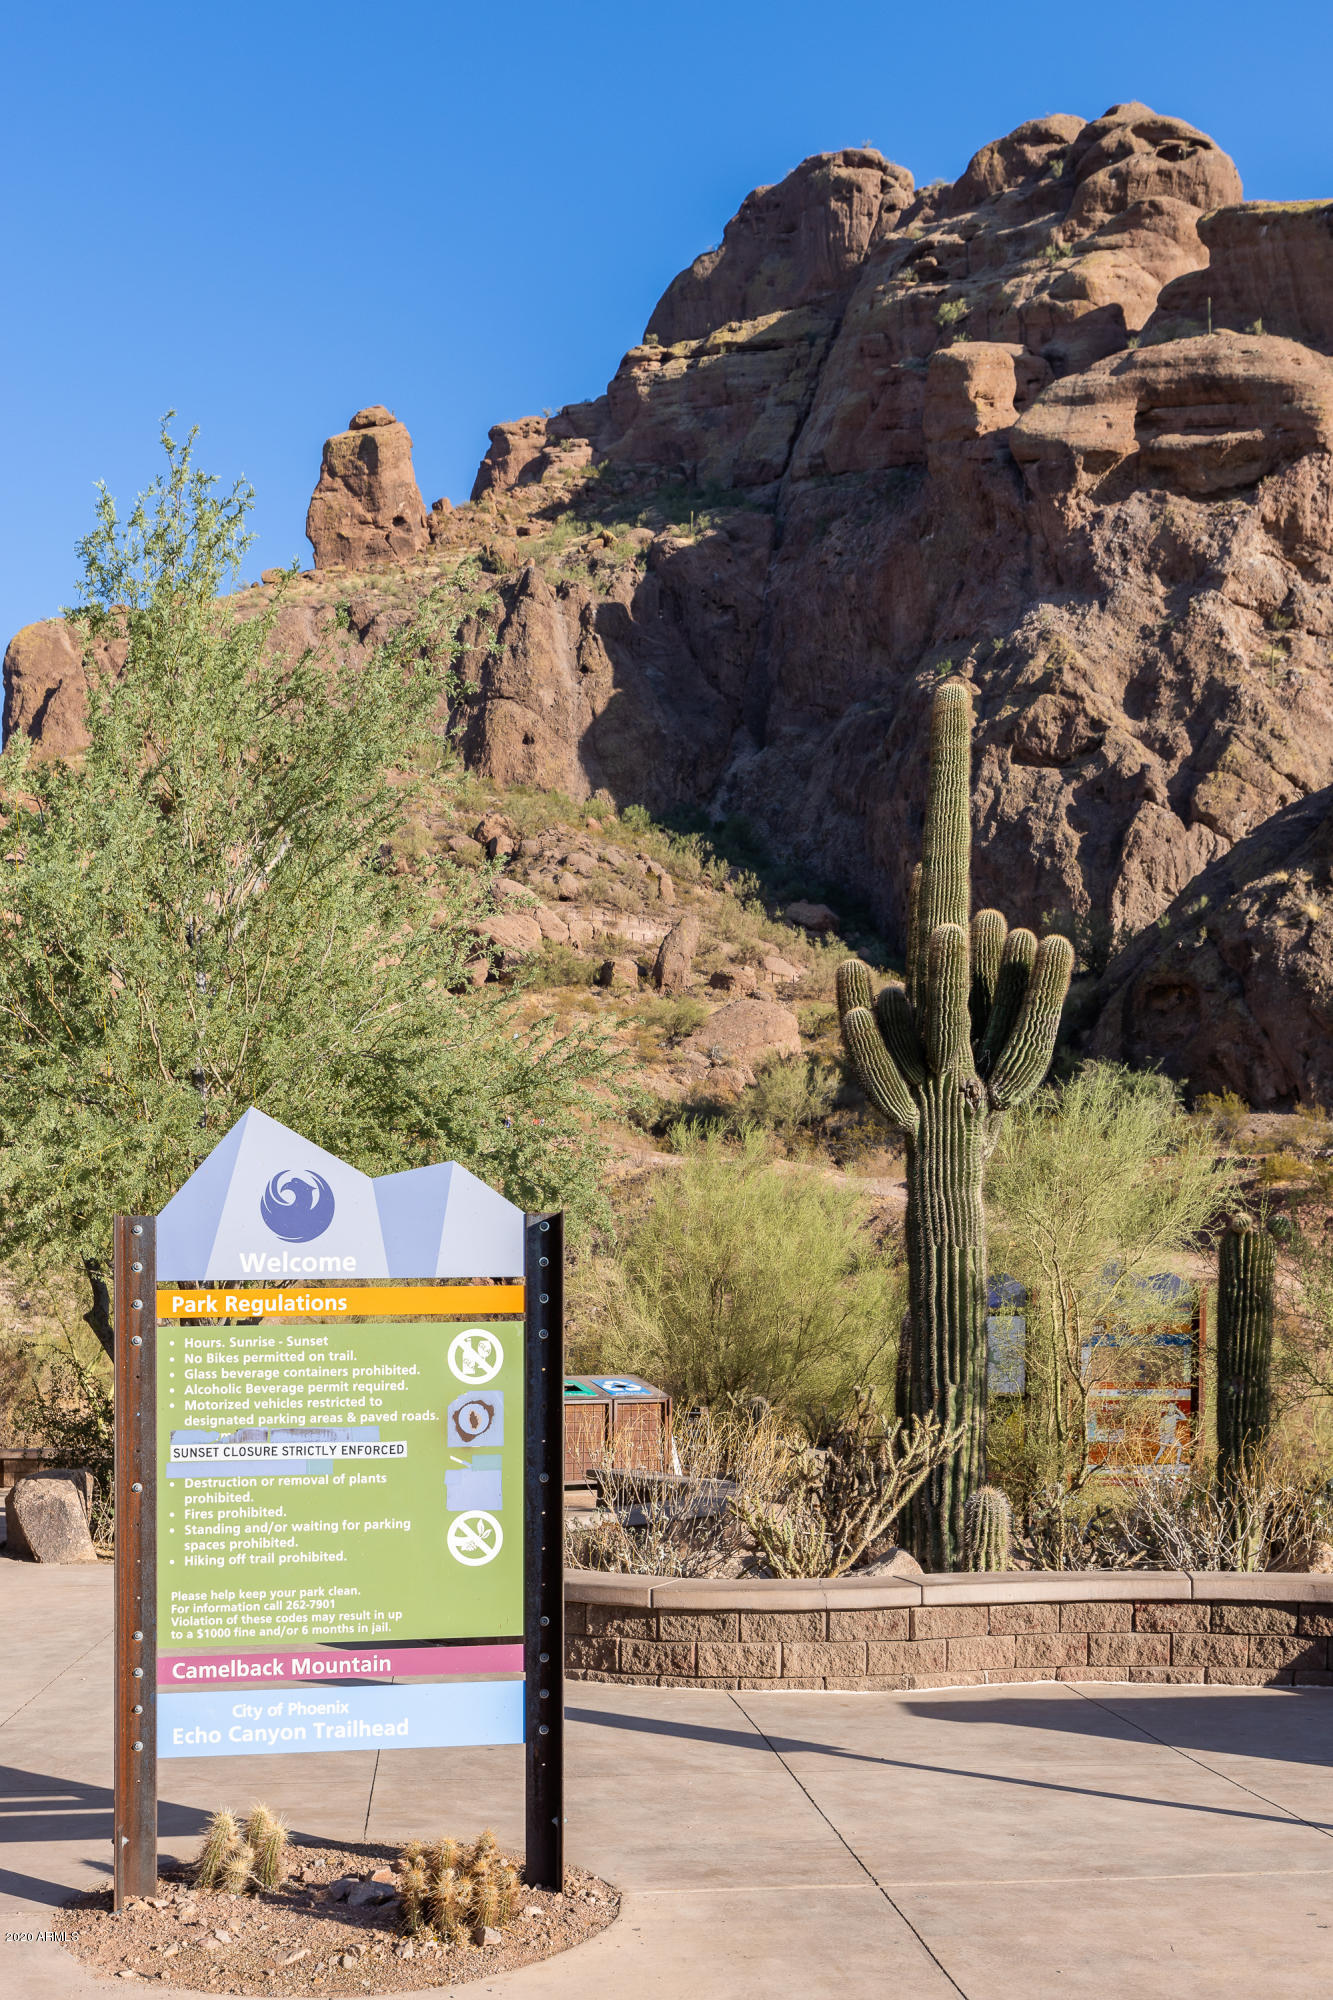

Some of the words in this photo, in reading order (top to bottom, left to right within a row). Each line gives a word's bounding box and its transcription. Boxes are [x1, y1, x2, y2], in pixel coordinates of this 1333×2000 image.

[240, 1251, 356, 1272] Welcome
[173, 1295, 217, 1312] Park
[226, 1294, 347, 1316] Regulations
[185, 1338, 224, 1348] Hours.
[230, 1336, 275, 1347] Sunrise
[287, 1336, 328, 1346] Sunset
[185, 1354, 202, 1363] No
[207, 1352, 239, 1363] Bikes
[243, 1351, 304, 1365] permitted
[309, 1353, 324, 1361] on
[328, 1350, 357, 1361] trail.
[185, 1368, 217, 1379] Glass
[222, 1368, 279, 1380] beverage
[283, 1366, 348, 1377] containers
[352, 1364, 420, 1378] prohibited.
[184, 1384, 241, 1394] Alcoholic
[246, 1384, 304, 1395] Beverage
[308, 1381, 348, 1395] permit
[353, 1380, 408, 1393] required.
[185, 1399, 249, 1410] Motorized
[254, 1398, 303, 1408] vehicles
[308, 1396, 365, 1408] restricted
[369, 1397, 382, 1406] to
[184, 1414, 254, 1429] designated
[258, 1413, 306, 1427] parking
[310, 1415, 343, 1423] areas
[347, 1412, 356, 1422] &
[360, 1412, 398, 1426] paved
[401, 1410, 439, 1421] roads.
[174, 1448, 219, 1458] SUNSET
[224, 1447, 277, 1456] CLOSURE
[282, 1446, 336, 1456] STRICTLY
[342, 1445, 404, 1455] ENFORCED
[184, 1476, 257, 1488] Destruction
[261, 1478, 274, 1486] or
[279, 1474, 328, 1485] removal
[333, 1474, 345, 1484] of
[349, 1473, 386, 1486] plants
[185, 1491, 253, 1506] prohibited.
[185, 1509, 213, 1519] Fires
[218, 1506, 286, 1521] prohibited.
[185, 1523, 240, 1536] Standing
[245, 1522, 287, 1535] and/or
[292, 1520, 338, 1533] waiting
[342, 1520, 360, 1530] for
[364, 1518, 410, 1532] parking
[184, 1542, 225, 1552] spaces
[230, 1536, 298, 1551] prohibited.
[185, 1555, 224, 1568] Hiking
[229, 1554, 246, 1564] off
[250, 1552, 274, 1564] trail
[279, 1551, 347, 1565] prohibited.
[172, 1592, 207, 1601] Please
[211, 1589, 235, 1601] help
[239, 1589, 266, 1600] keep
[270, 1590, 296, 1602] your
[300, 1587, 324, 1599] park
[328, 1586, 360, 1596] clean.
[171, 1604, 190, 1614] For
[193, 1602, 260, 1613] information
[264, 1600, 282, 1610] call
[286, 1599, 334, 1610] 262-7901
[171, 1616, 222, 1626] Violation
[227, 1614, 238, 1624] of
[241, 1614, 272, 1624] these
[276, 1613, 308, 1623] codes
[312, 1614, 335, 1624] may
[339, 1610, 371, 1620] result
[374, 1610, 384, 1619] in
[388, 1612, 402, 1621] up
[171, 1631, 183, 1639] to
[197, 1628, 231, 1638] $1000
[234, 1627, 255, 1637] fine
[260, 1626, 298, 1637] and/or
[302, 1625, 308, 1634] 6
[312, 1624, 354, 1634] months
[358, 1623, 368, 1632] in
[372, 1622, 391, 1635] jail.
[172, 1658, 284, 1679] Camelback
[292, 1655, 390, 1674] Mountain
[232, 1704, 263, 1720] City
[267, 1702, 284, 1716] of
[288, 1700, 349, 1715] Phoenix
[173, 1726, 221, 1744] Echo
[229, 1726, 306, 1745] Canyon
[313, 1718, 408, 1738] Trailhead
